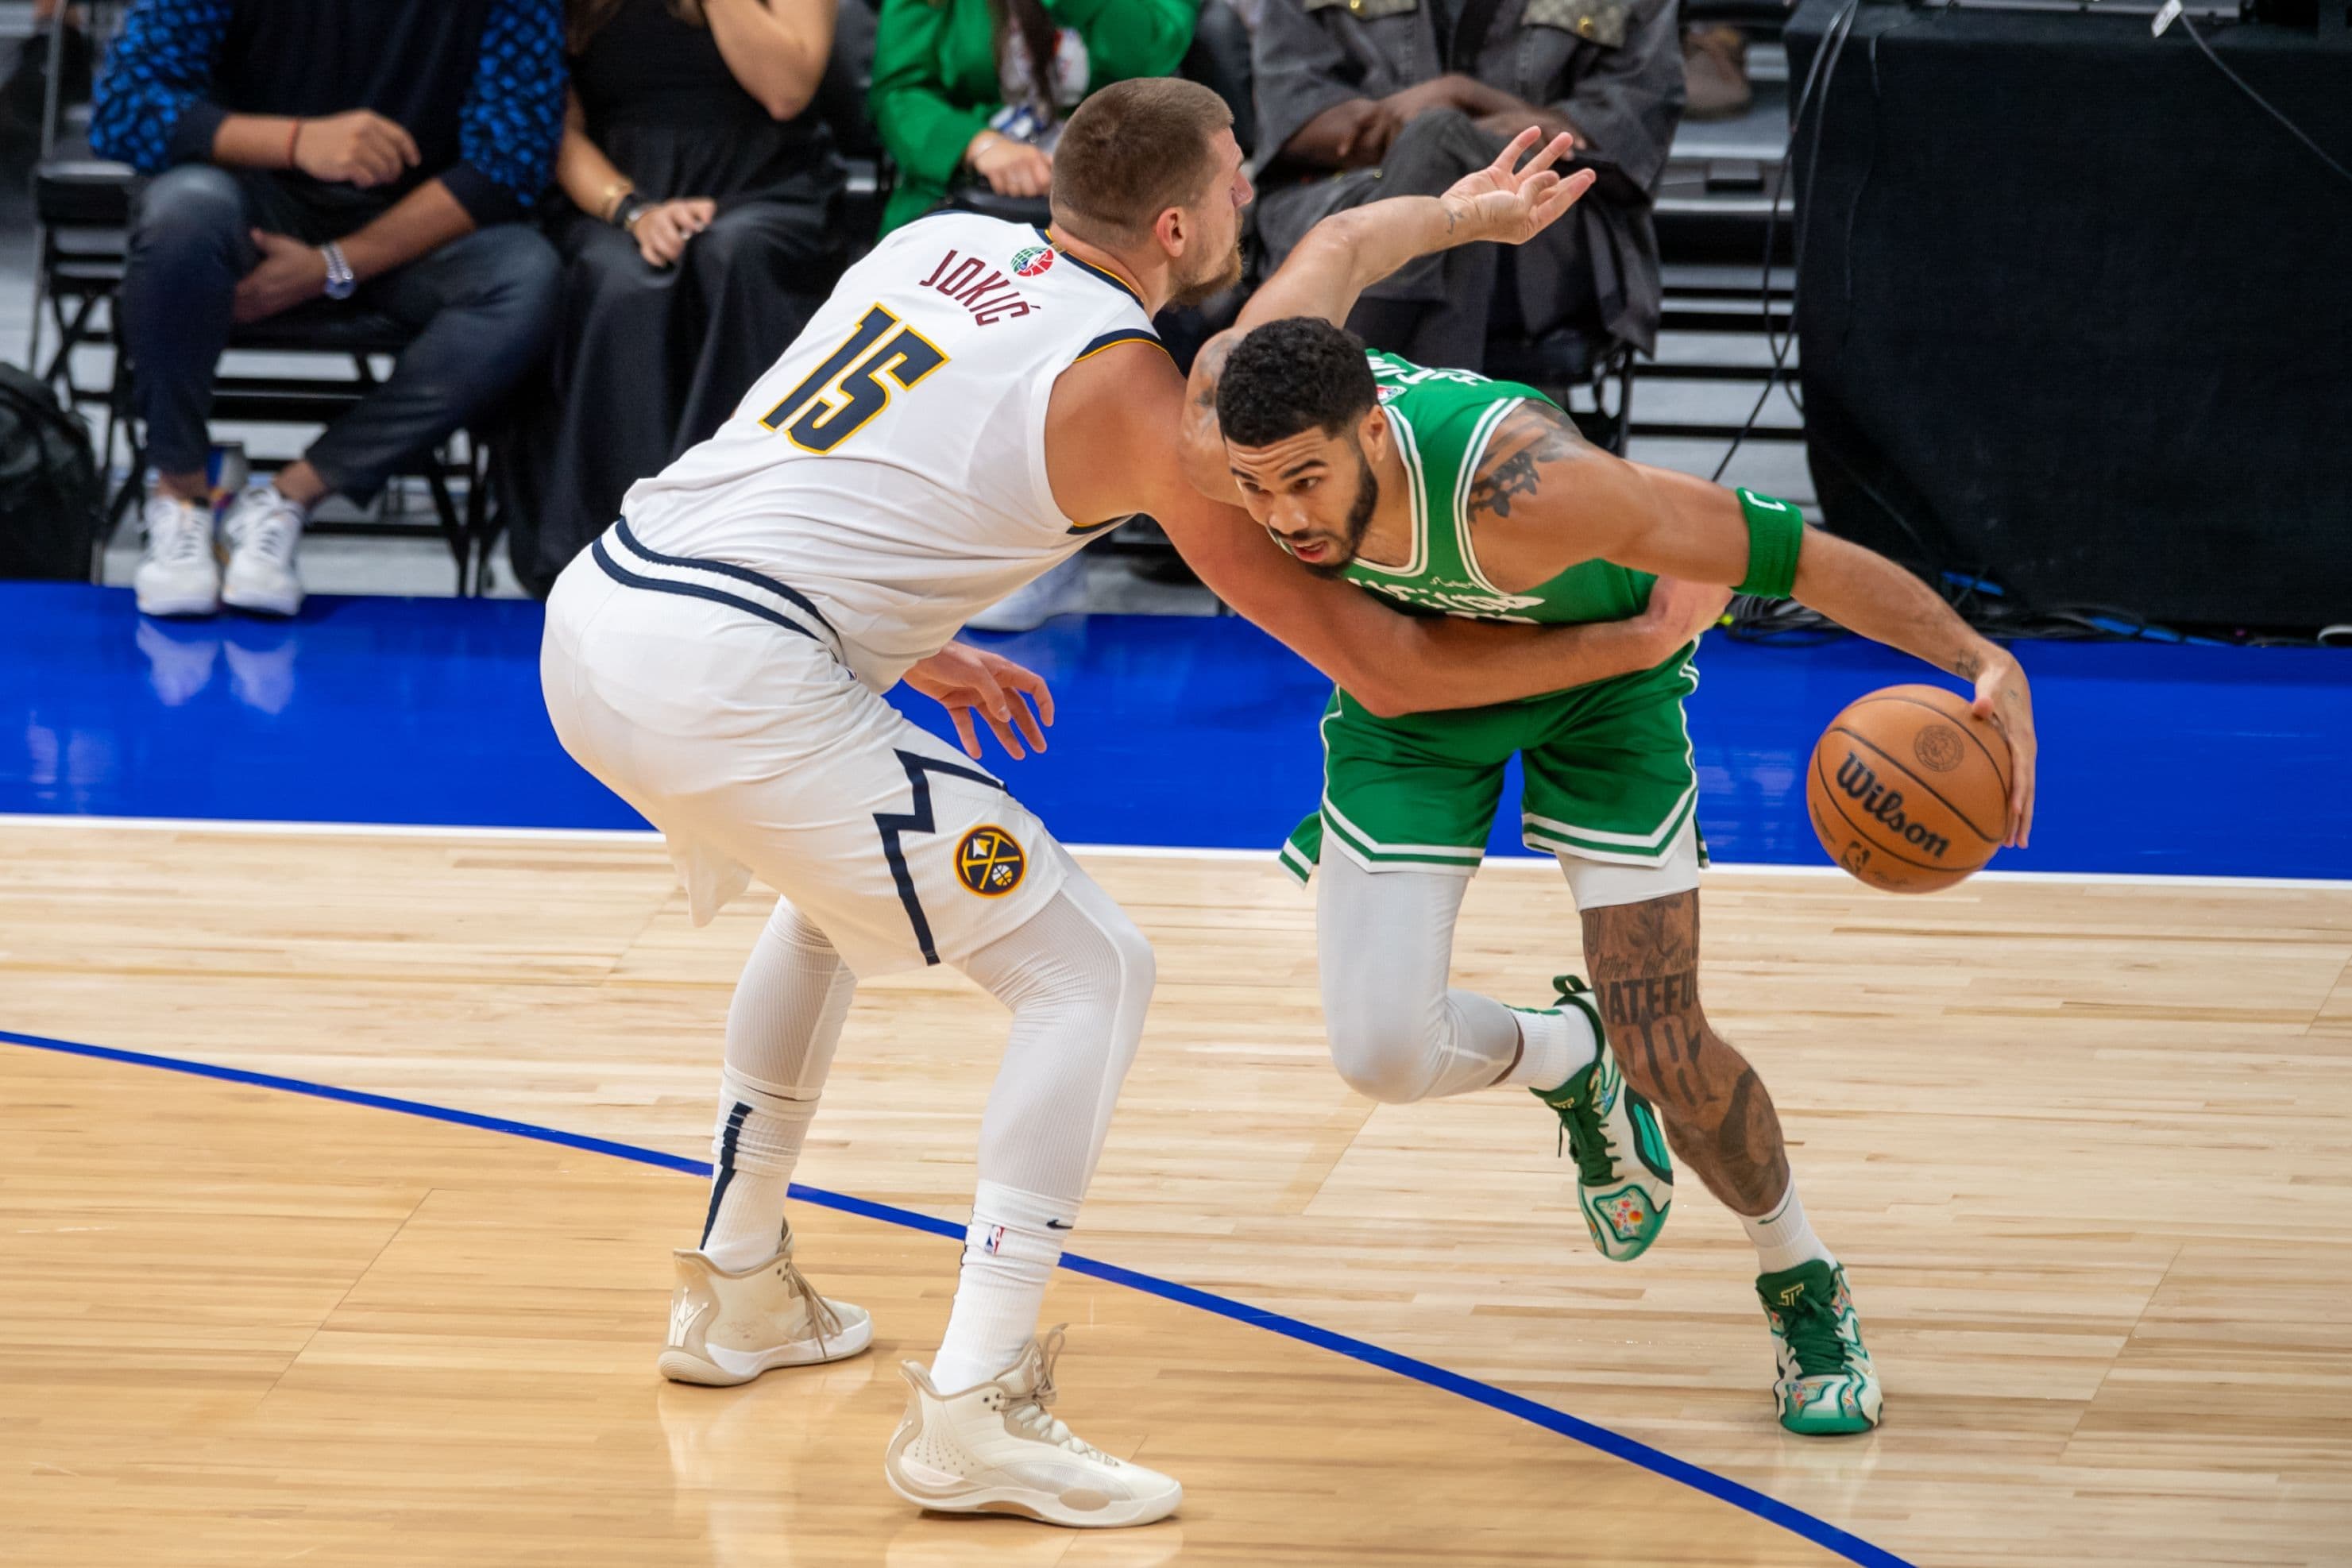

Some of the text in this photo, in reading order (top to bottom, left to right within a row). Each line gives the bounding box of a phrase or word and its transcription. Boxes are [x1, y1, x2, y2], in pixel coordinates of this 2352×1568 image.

[918, 249, 1041, 326] JOKIĆ
[757, 301, 952, 455] 15
[1836, 749, 1951, 859] Wilson
